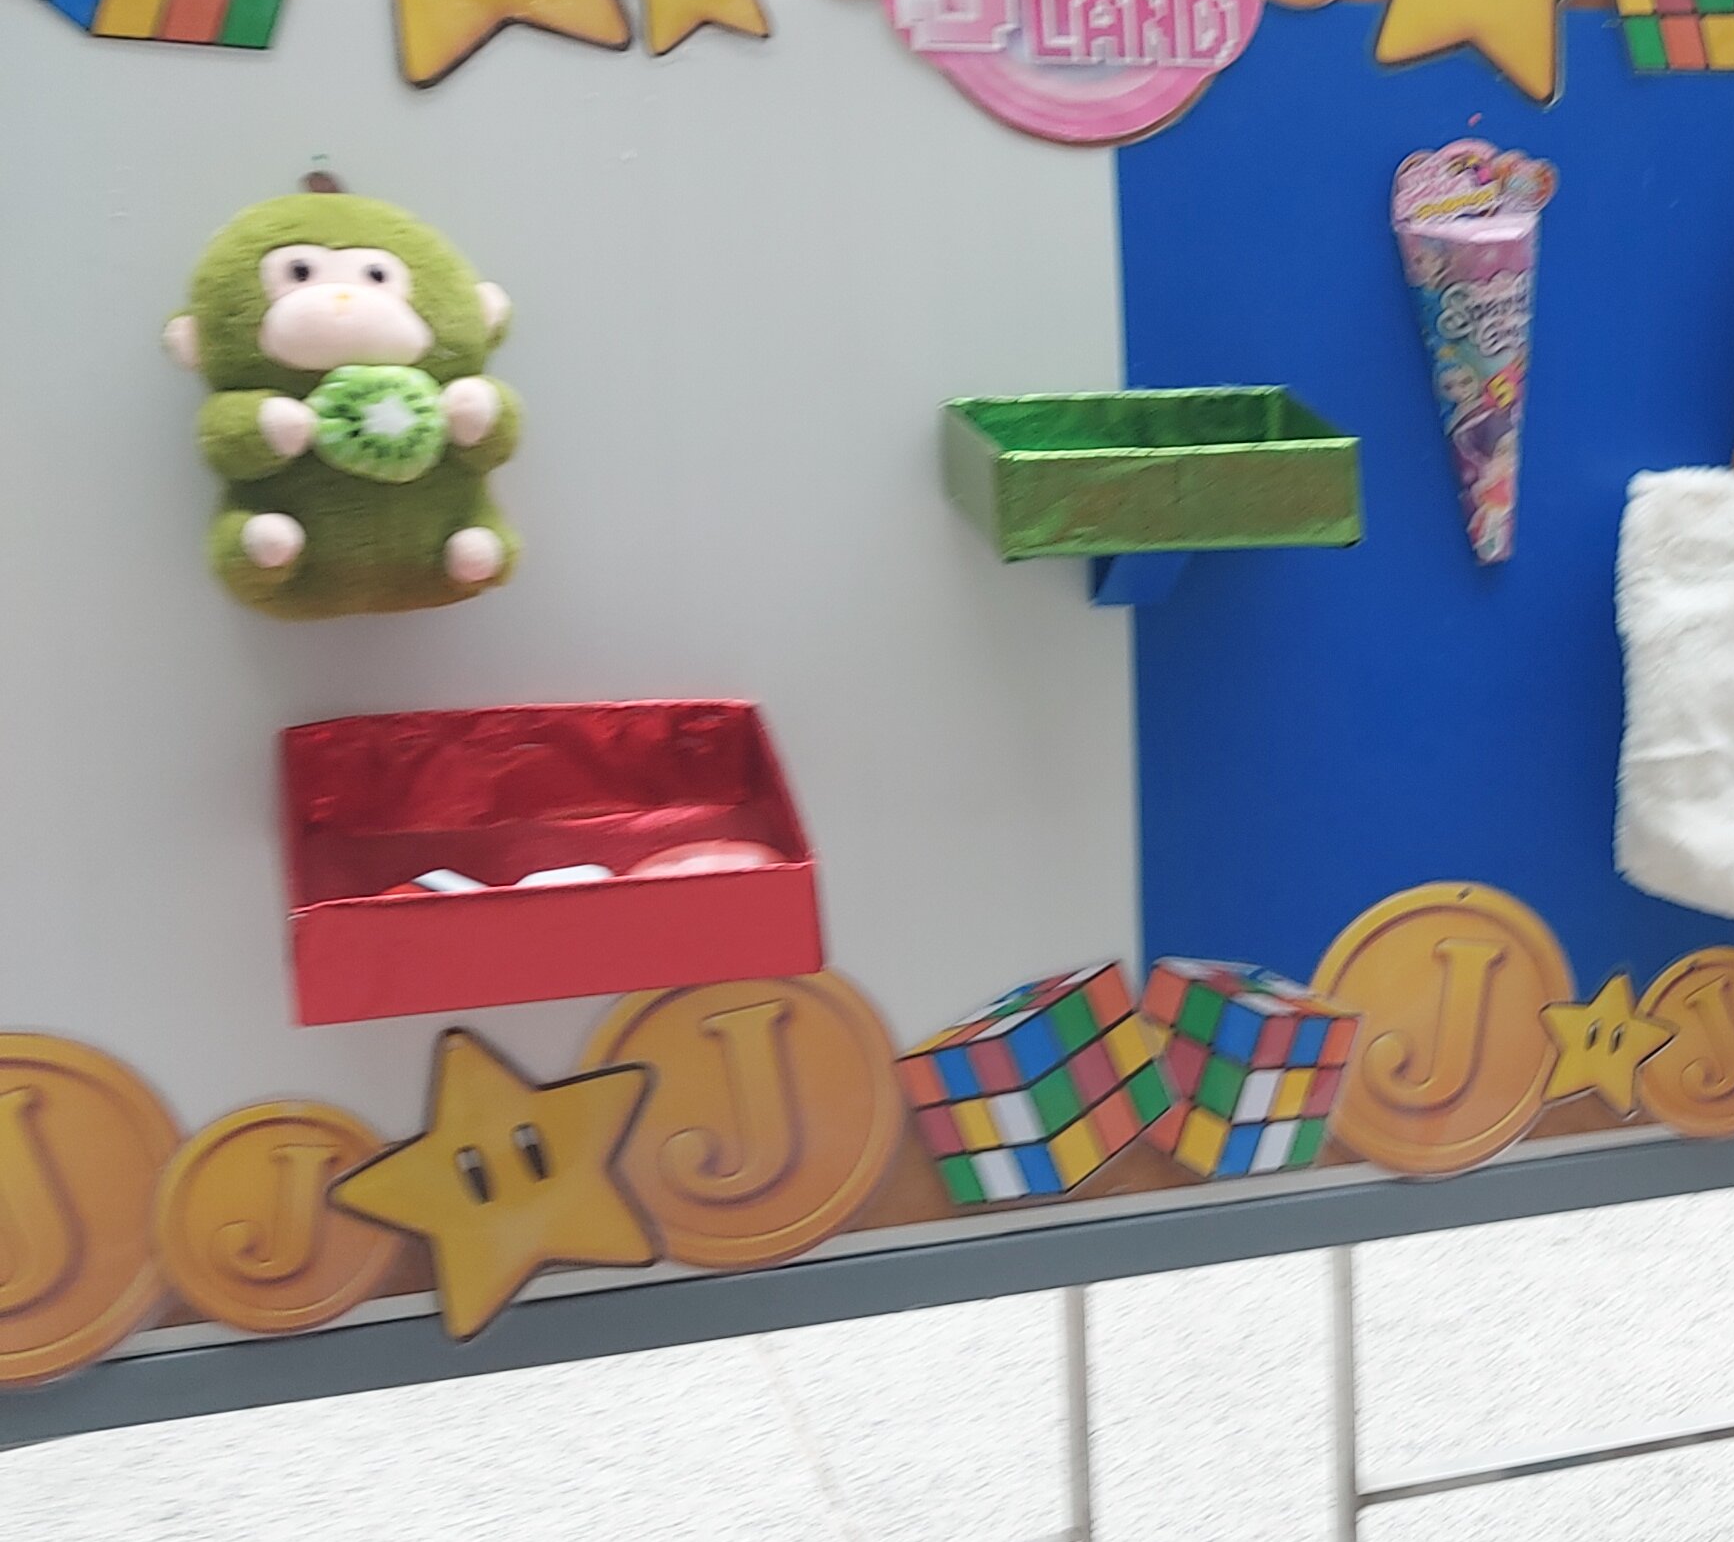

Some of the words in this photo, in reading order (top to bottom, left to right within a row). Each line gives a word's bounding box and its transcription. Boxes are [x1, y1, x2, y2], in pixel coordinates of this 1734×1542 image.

[660, 1000, 796, 1205] J
[1367, 937, 1508, 1111] J
[214, 1144, 344, 1285] J
